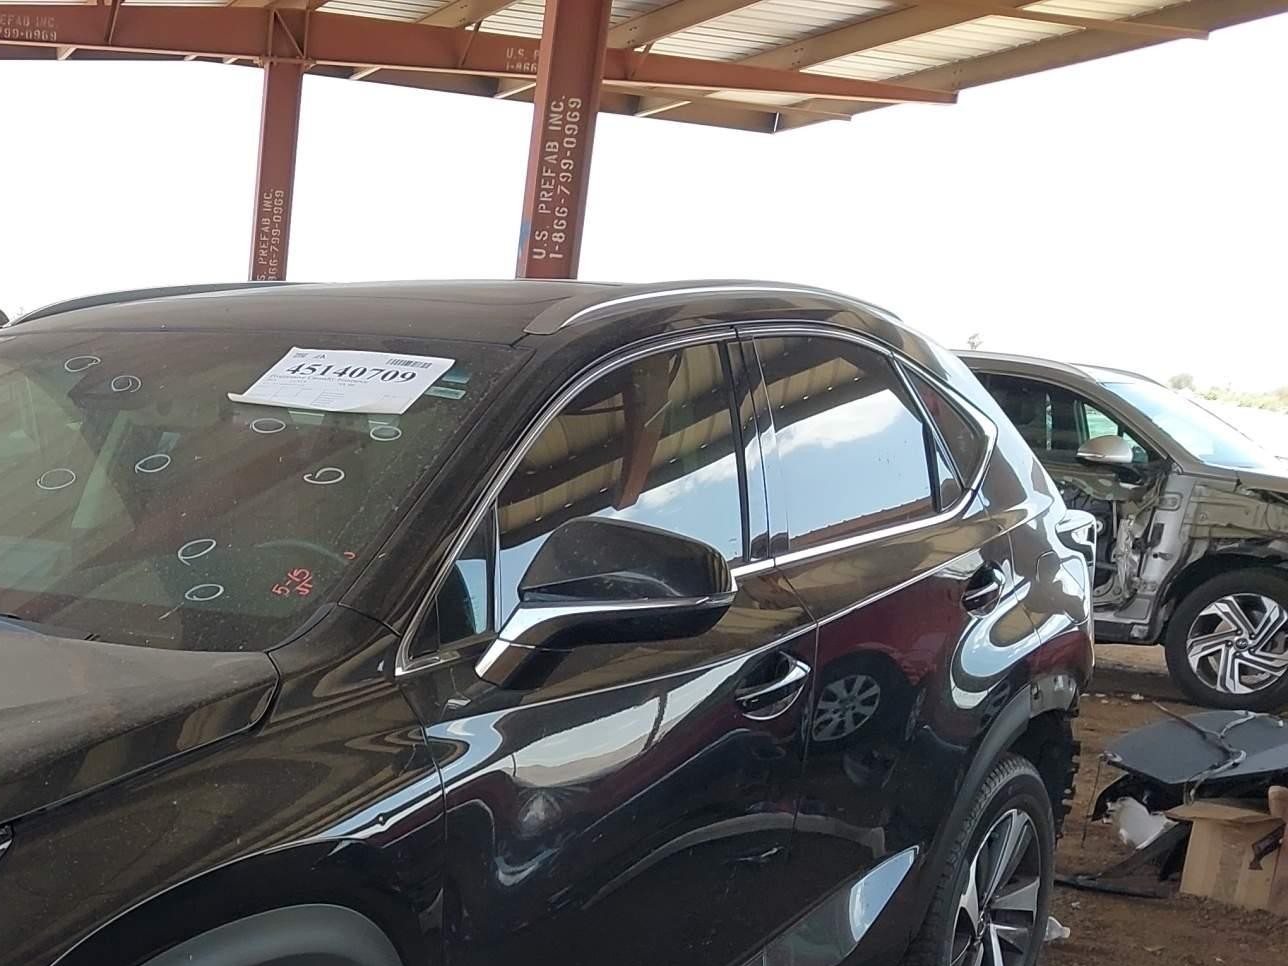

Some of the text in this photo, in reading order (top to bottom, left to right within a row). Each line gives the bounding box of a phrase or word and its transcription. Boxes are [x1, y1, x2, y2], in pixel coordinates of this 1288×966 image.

[263, 188, 274, 212] INC.
[532, 95, 566, 260] U.S. PREFAB INC.
[549, 97, 582, 259] 1-866-799-0969
[258, 217, 271, 265] PREFAB
[286, 362, 417, 384] 45140709
